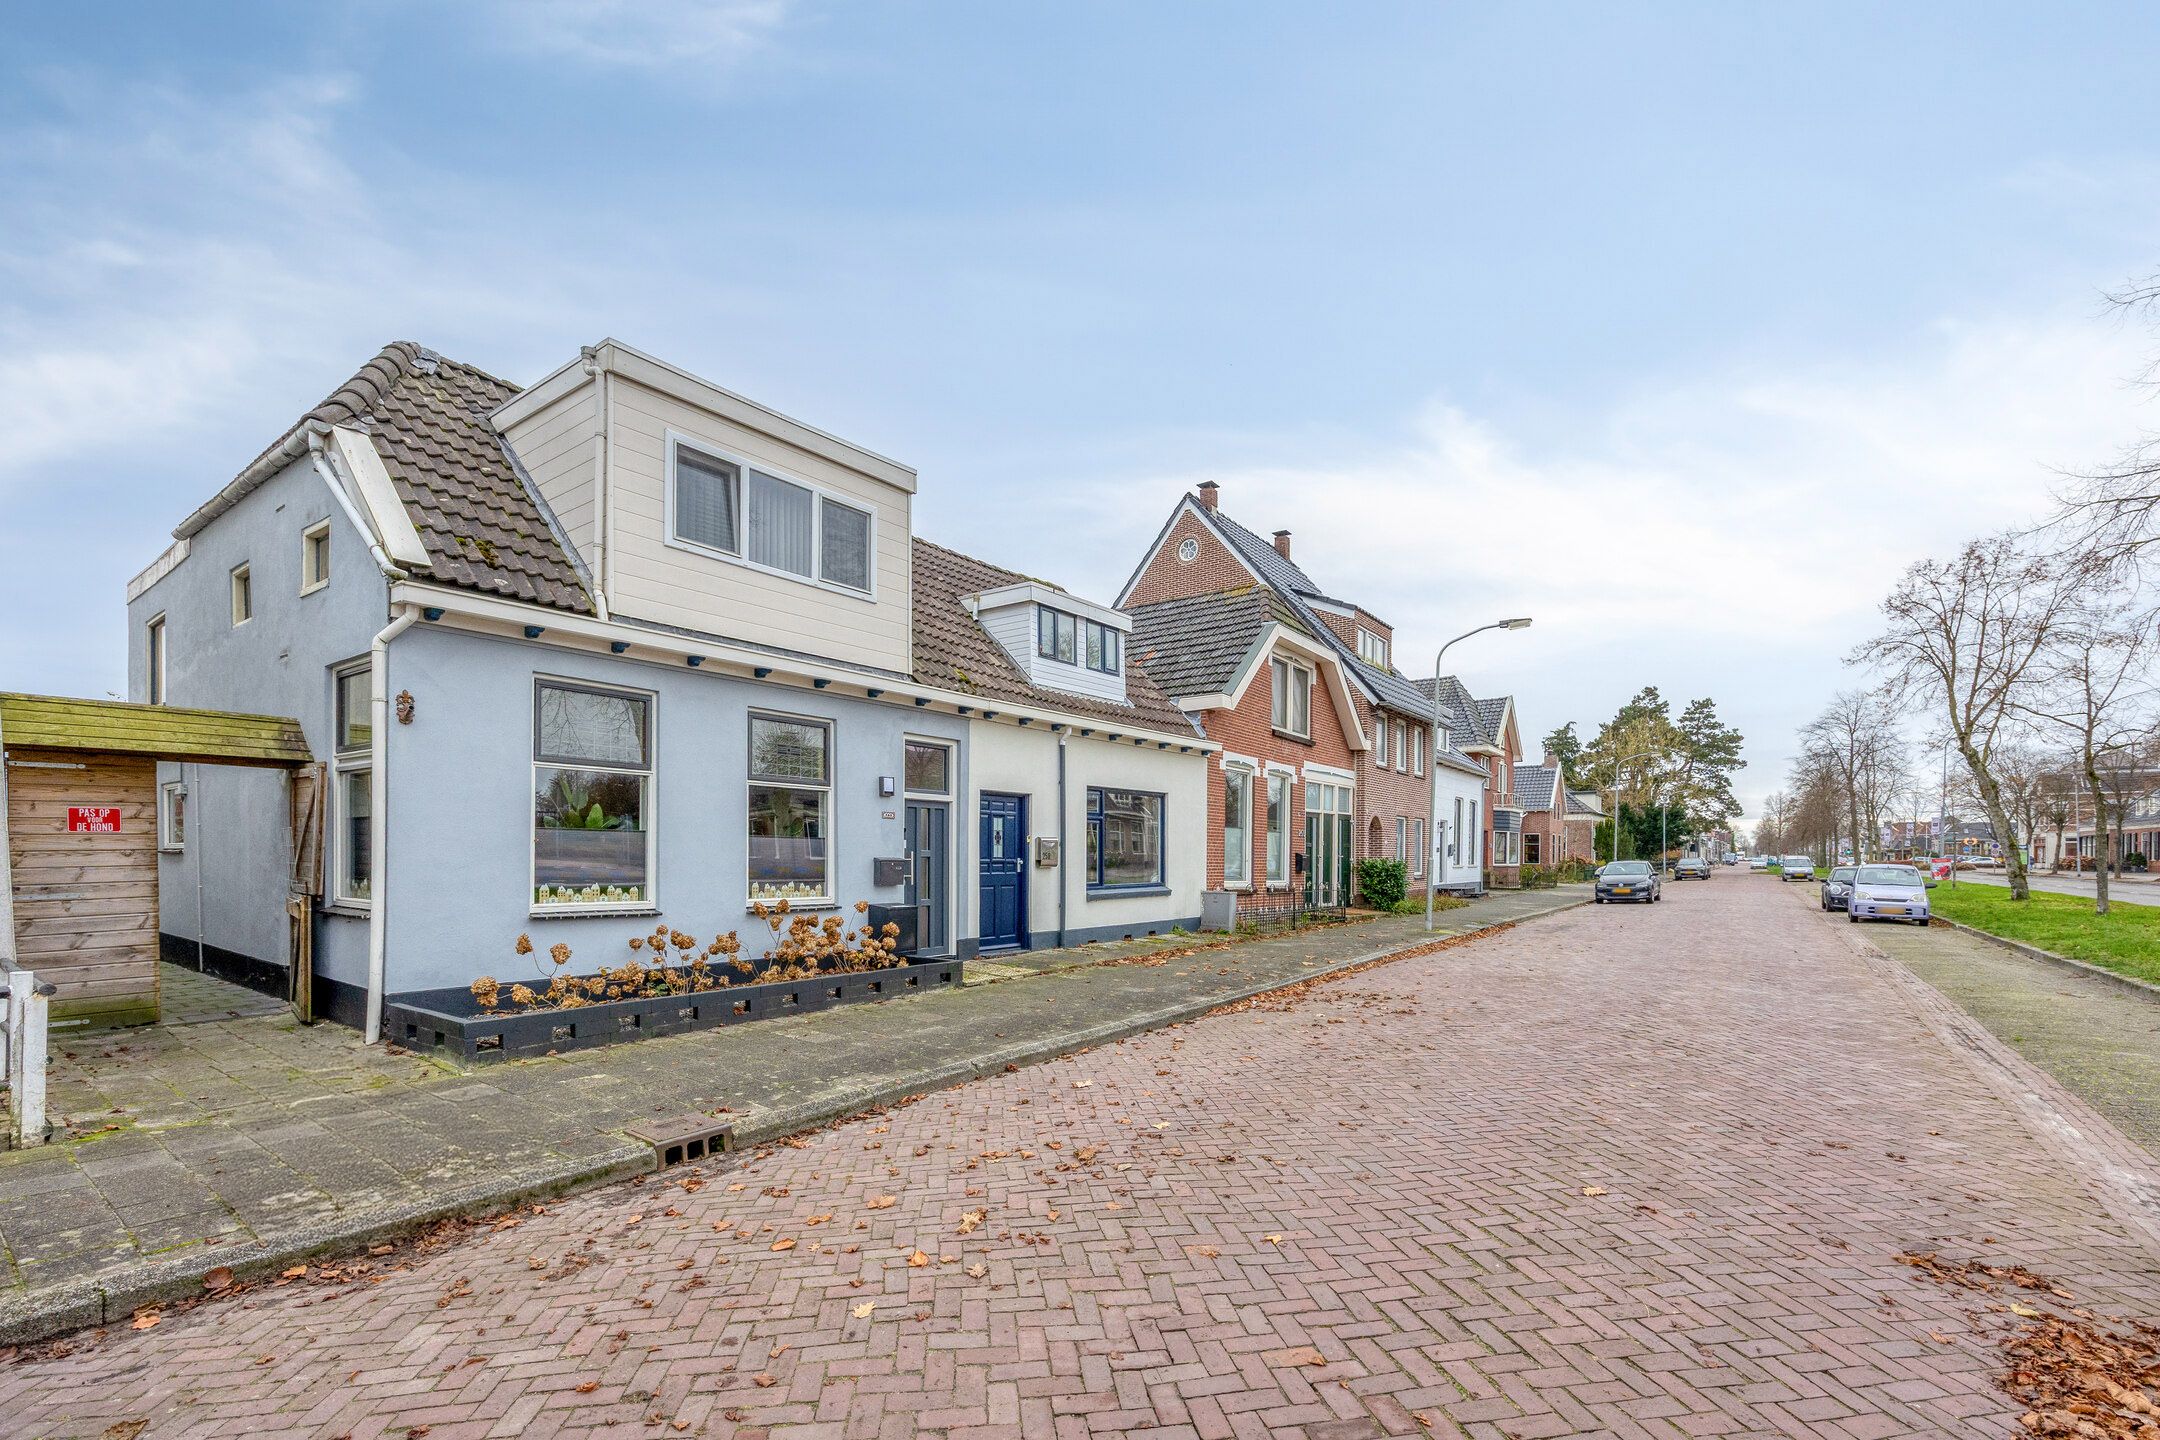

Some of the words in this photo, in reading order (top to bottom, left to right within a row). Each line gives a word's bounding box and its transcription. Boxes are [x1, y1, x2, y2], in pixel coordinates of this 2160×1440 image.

[79, 808, 96, 817] PAS
[99, 808, 110, 817] OP
[77, 823, 87, 832] DE
[91, 823, 114, 832] HOND
